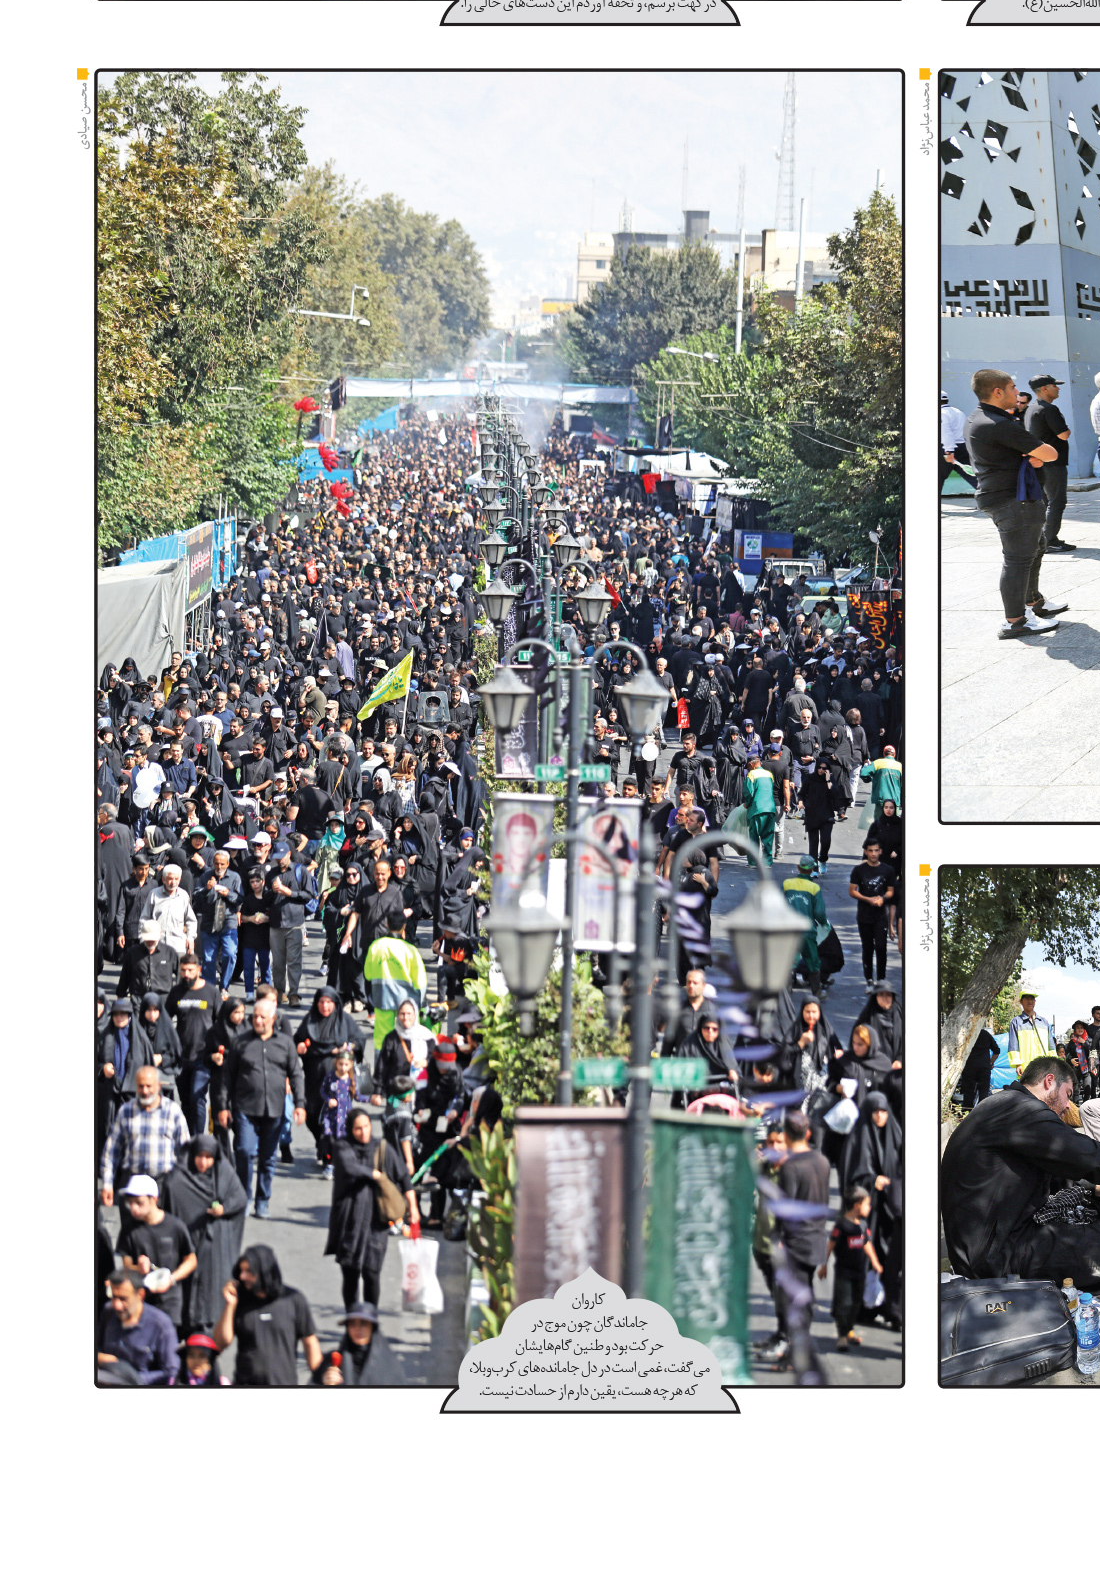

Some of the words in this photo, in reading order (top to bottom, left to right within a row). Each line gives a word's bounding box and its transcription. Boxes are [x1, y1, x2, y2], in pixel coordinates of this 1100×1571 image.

[82, 83, 91, 114] محسن
[78, 117, 90, 149] صیادی
[572, 1293, 605, 1309] کاروان
[985, 1301, 1008, 1314] CAT
